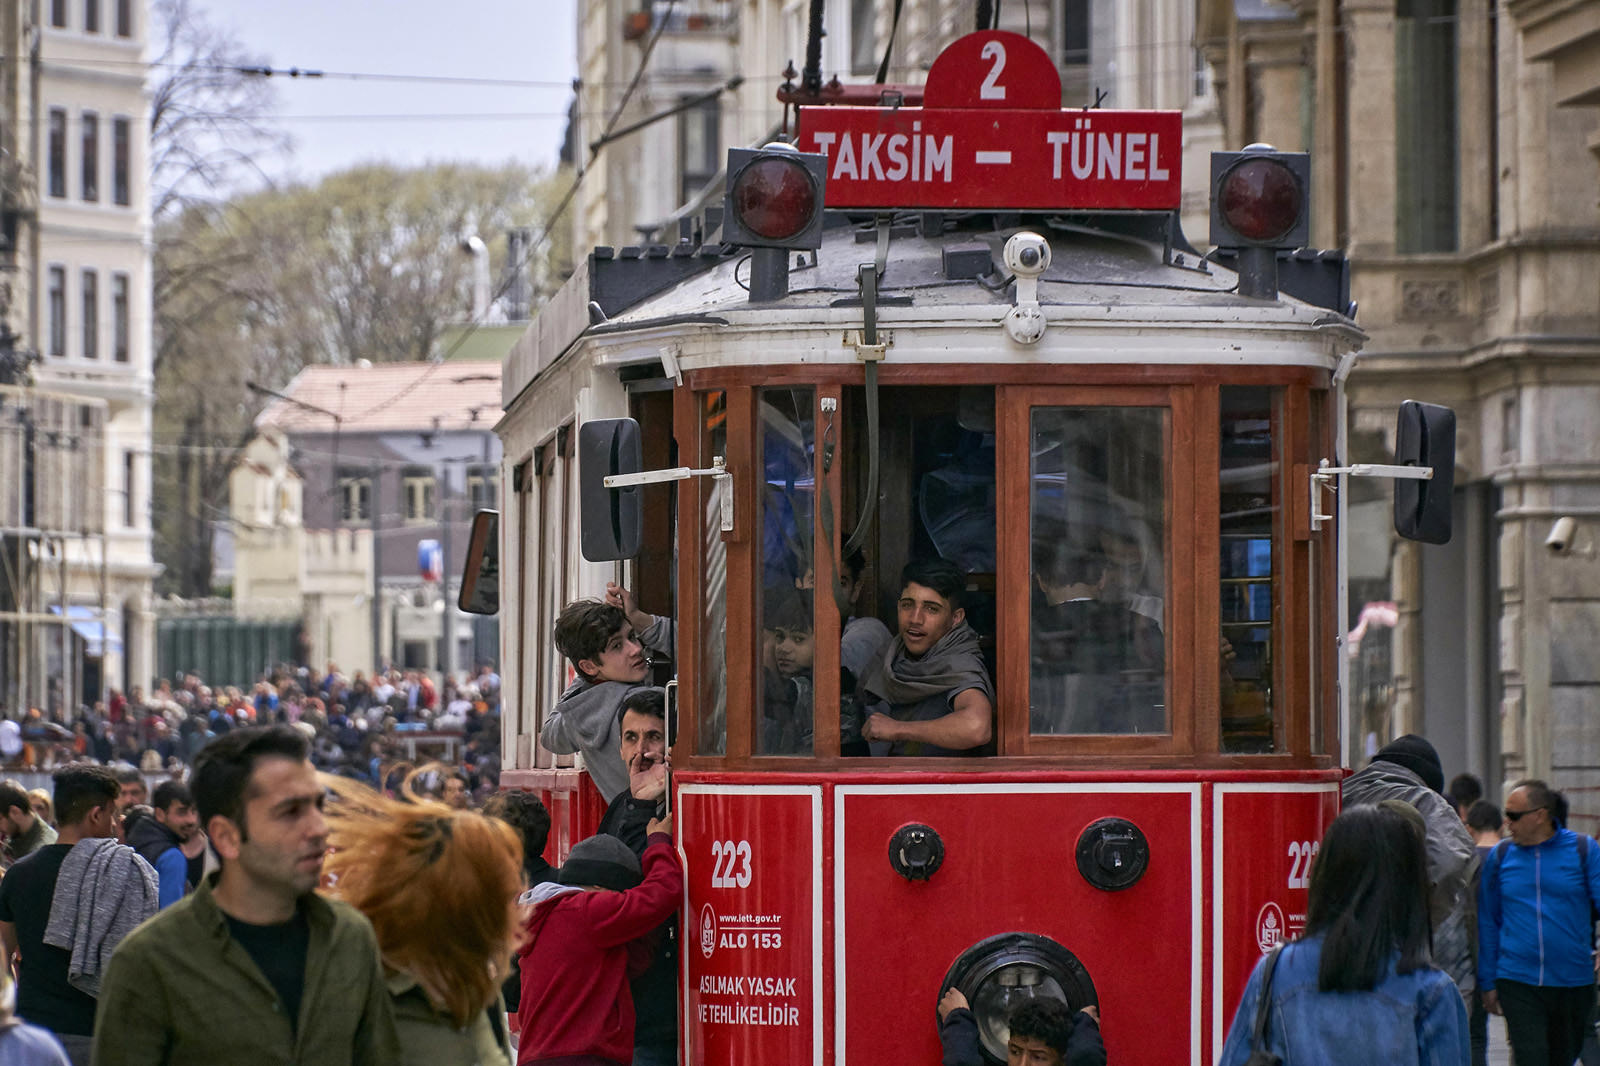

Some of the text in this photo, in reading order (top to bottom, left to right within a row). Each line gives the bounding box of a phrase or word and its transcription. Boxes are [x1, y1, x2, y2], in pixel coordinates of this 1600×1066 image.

[980, 41, 1007, 100] 2
[813, 121, 954, 182] TAKSİM
[1047, 119, 1170, 181] TÜNEL
[711, 840, 752, 889] 223
[1288, 840, 1320, 889] 22
[719, 914, 782, 925] www.iett.gov.tr
[719, 933, 782, 949] ALO 153
[699, 975, 797, 997] ASILMAK YASAK
[697, 1001, 800, 1026] VE TEHLİKELİDİR
